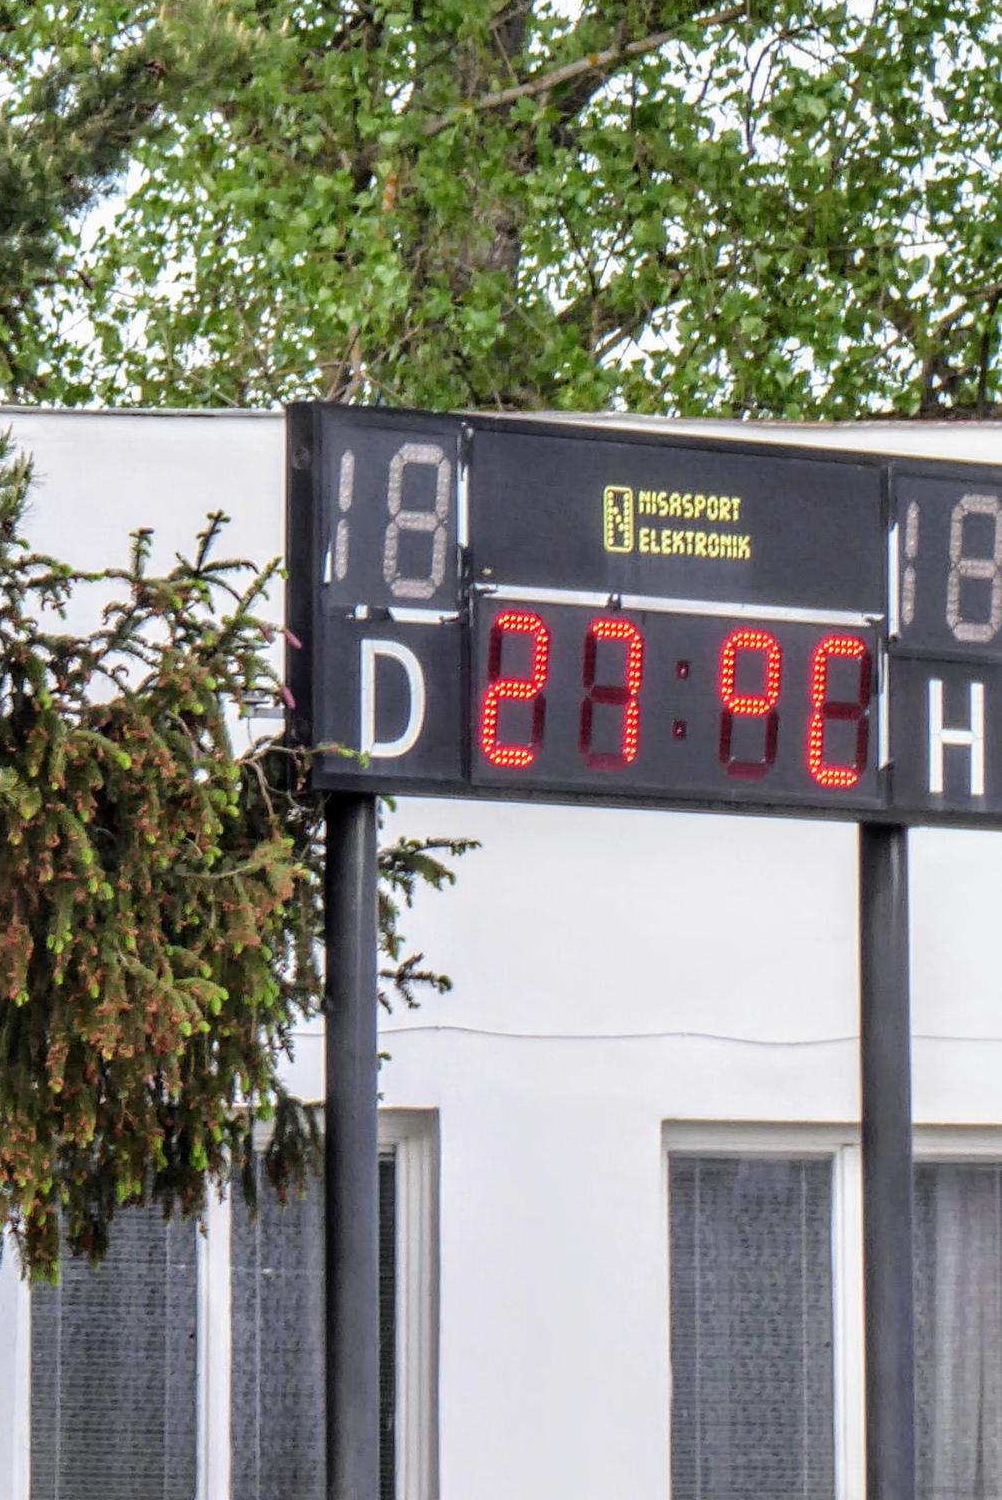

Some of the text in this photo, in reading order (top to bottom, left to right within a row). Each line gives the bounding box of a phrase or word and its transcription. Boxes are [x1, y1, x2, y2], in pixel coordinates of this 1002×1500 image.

[638, 490, 741, 521] NISASPORT
[638, 527, 750, 560] ELEKTRONIK
[360, 640, 425, 759] D
[927, 678, 986, 796] H
